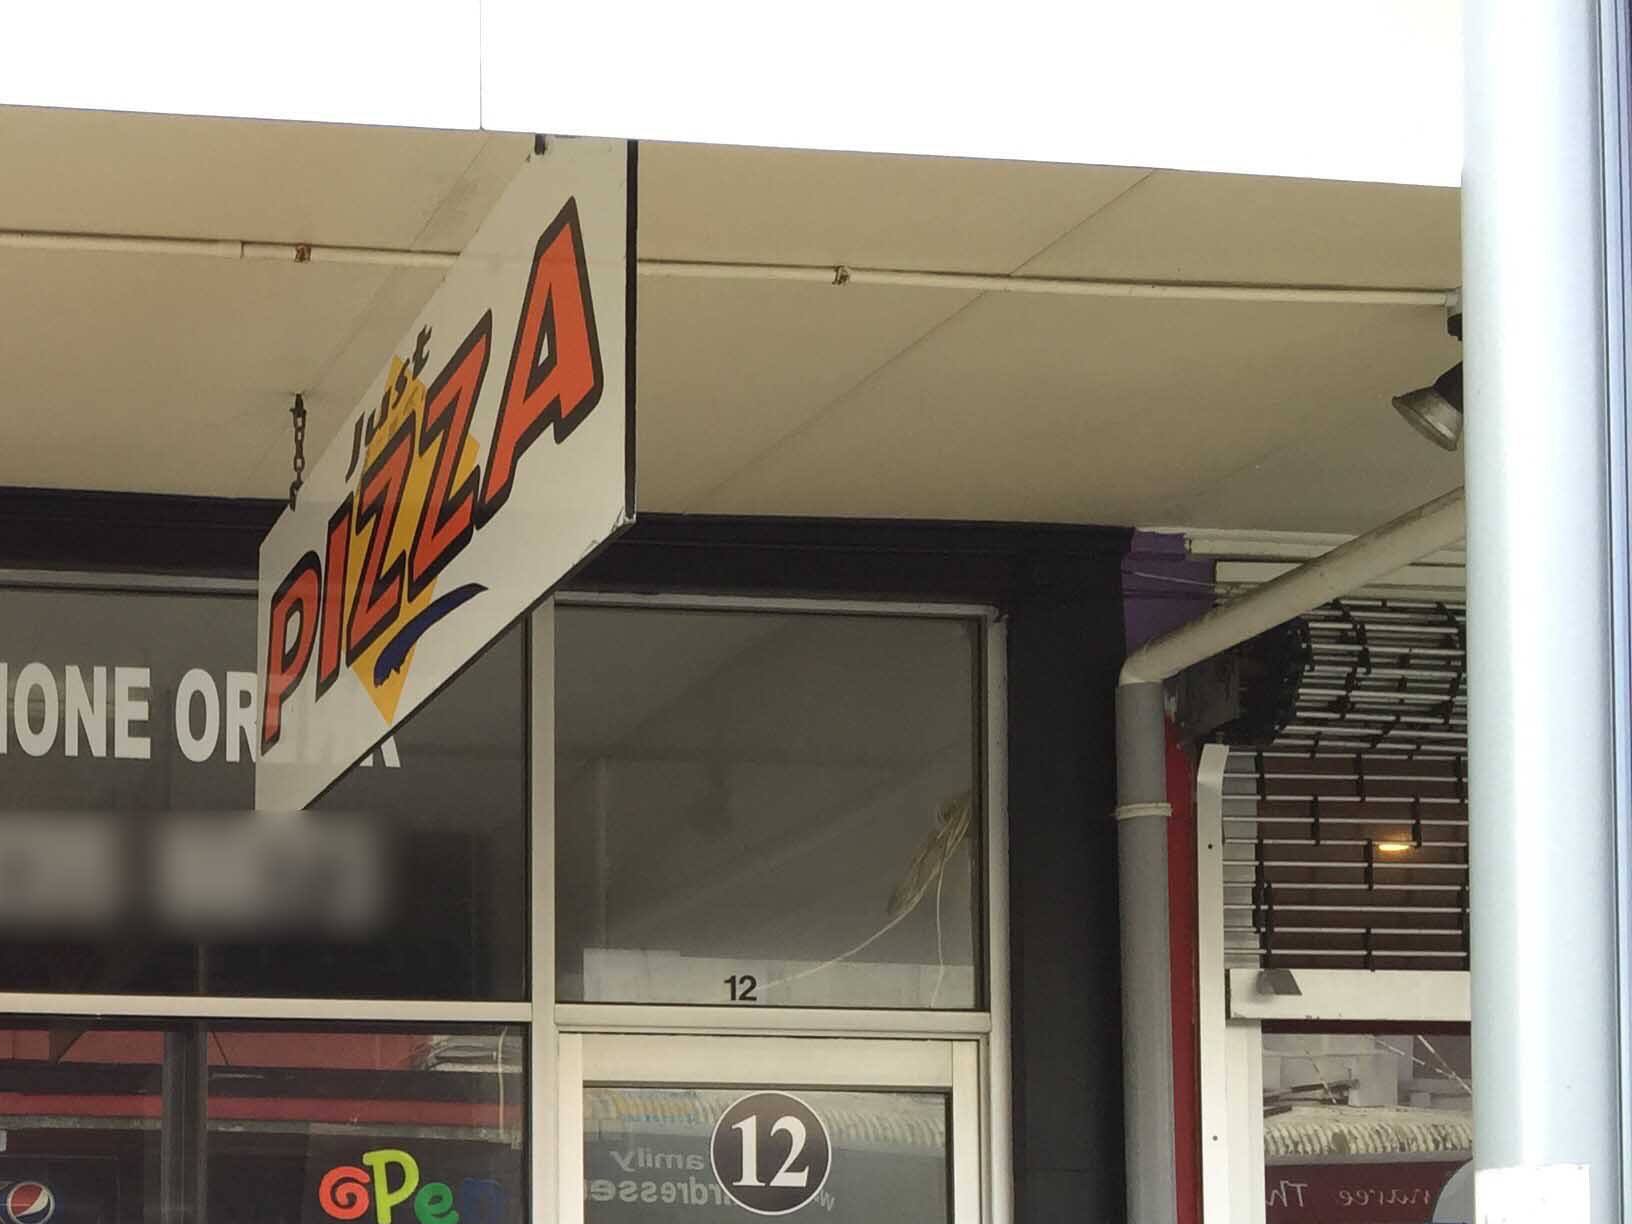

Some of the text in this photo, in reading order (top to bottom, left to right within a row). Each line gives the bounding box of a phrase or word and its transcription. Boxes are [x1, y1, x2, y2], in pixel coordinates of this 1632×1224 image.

[260, 195, 604, 757] PIZZA
[723, 975, 757, 1001] 12
[731, 1115, 810, 1188] 12
